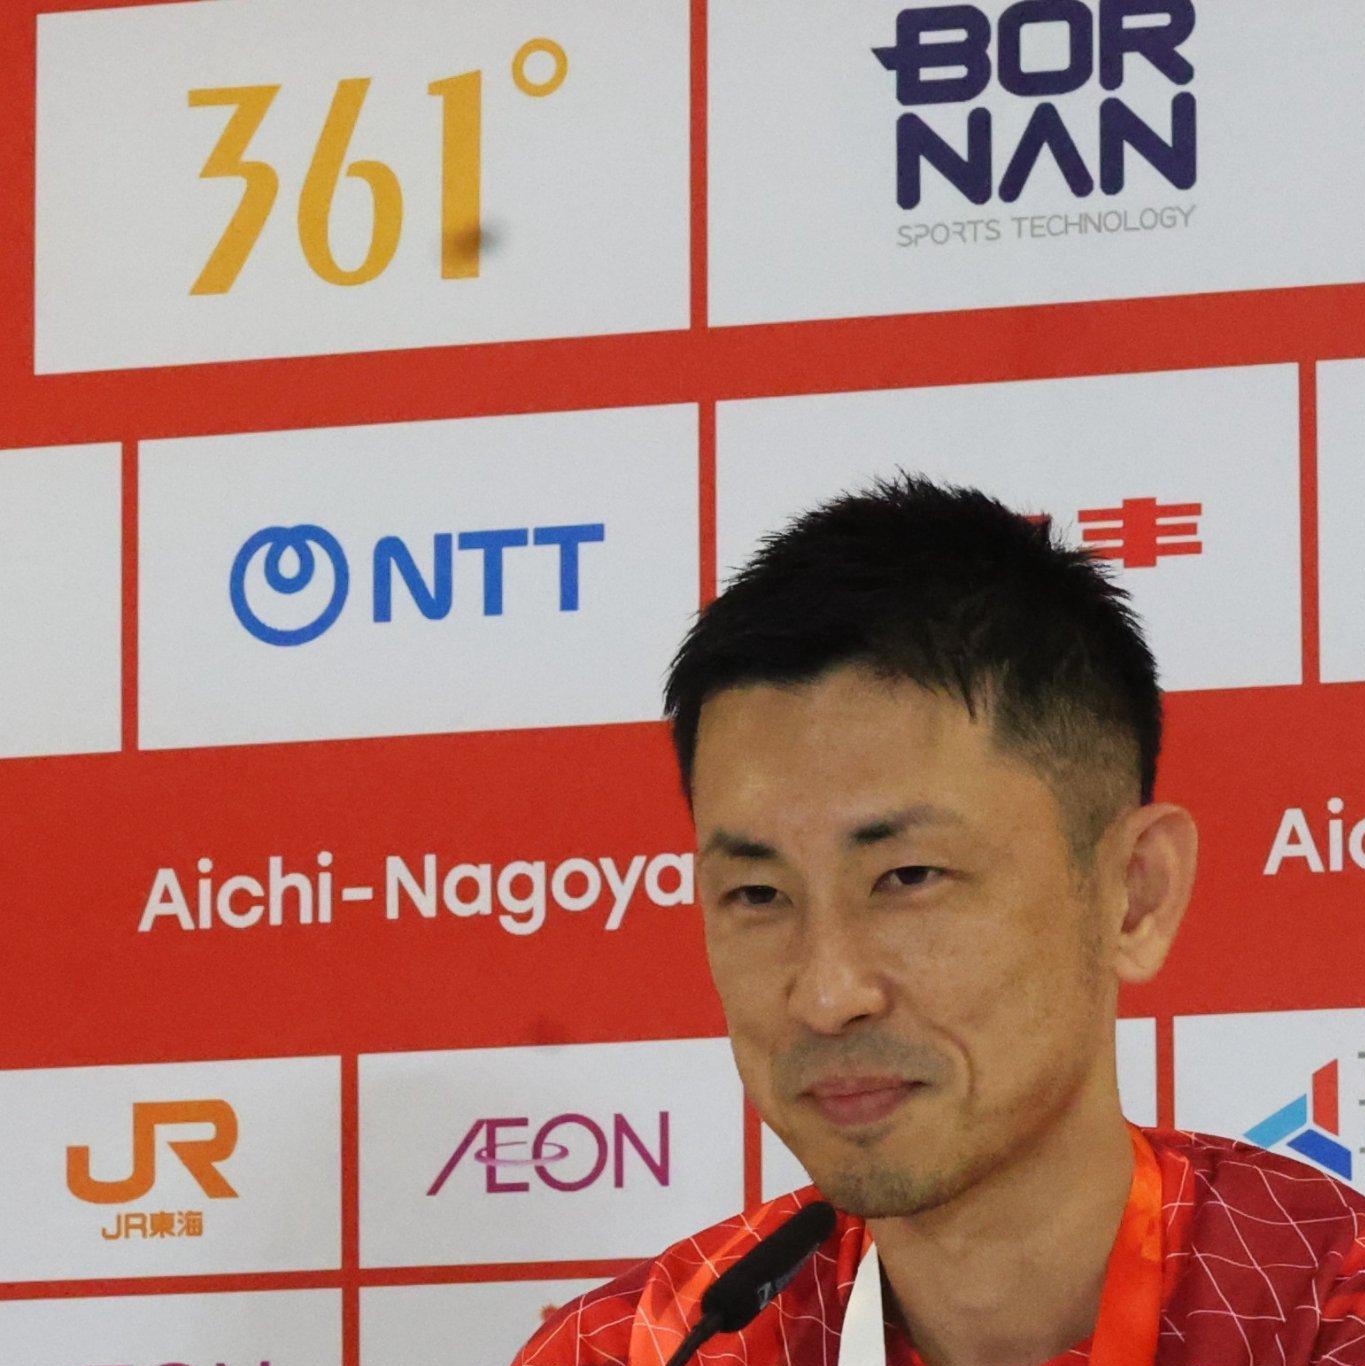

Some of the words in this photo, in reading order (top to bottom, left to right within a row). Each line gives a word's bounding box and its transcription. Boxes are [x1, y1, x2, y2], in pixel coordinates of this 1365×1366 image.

[870, 0, 1197, 106] BOR
[896, 91, 1197, 210] NAN
[897, 217, 1000, 248] SPORTS
[1010, 204, 1198, 240] TECHNOLOGY
[373, 523, 605, 622] NTT
[137, 850, 695, 936] Aichi-Nagoya
[66, 1098, 240, 1204] JR
[101, 1210, 204, 1241] JR東海
